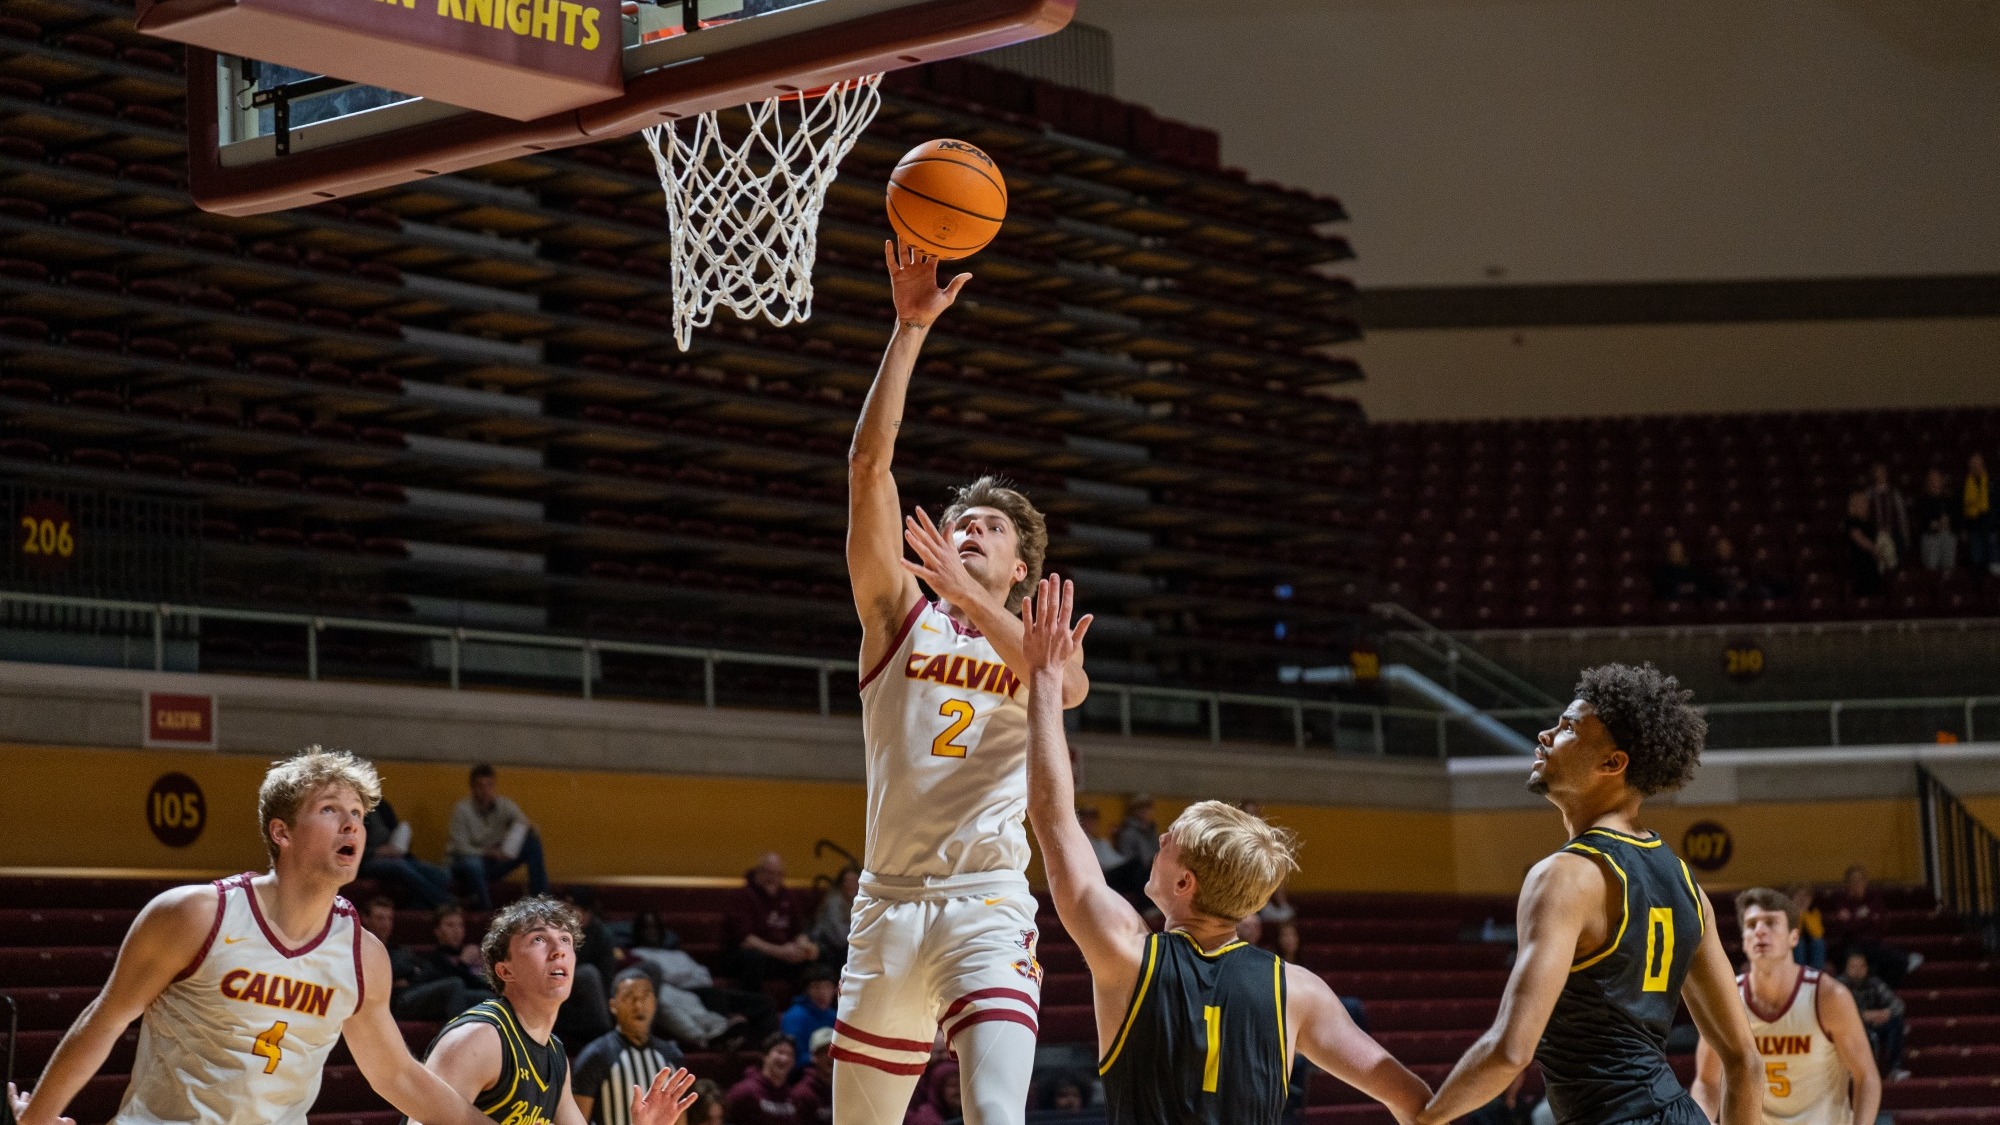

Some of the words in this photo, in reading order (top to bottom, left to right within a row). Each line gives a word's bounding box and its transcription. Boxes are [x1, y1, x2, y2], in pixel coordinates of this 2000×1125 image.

[938, 140, 993, 168] NCAA
[22, 517, 74, 557] 206
[905, 652, 1021, 700] CALVIN
[931, 698, 975, 759] 2
[154, 792, 200, 828] 105
[1687, 832, 1726, 859] 107
[1642, 907, 1675, 992] 0
[220, 968, 336, 1018] CALVIN
[251, 1020, 288, 1074] 4
[1202, 1005, 1220, 1093] 1
[1754, 1034, 1812, 1055] LVIN
[1764, 1061, 1791, 1098] 5
